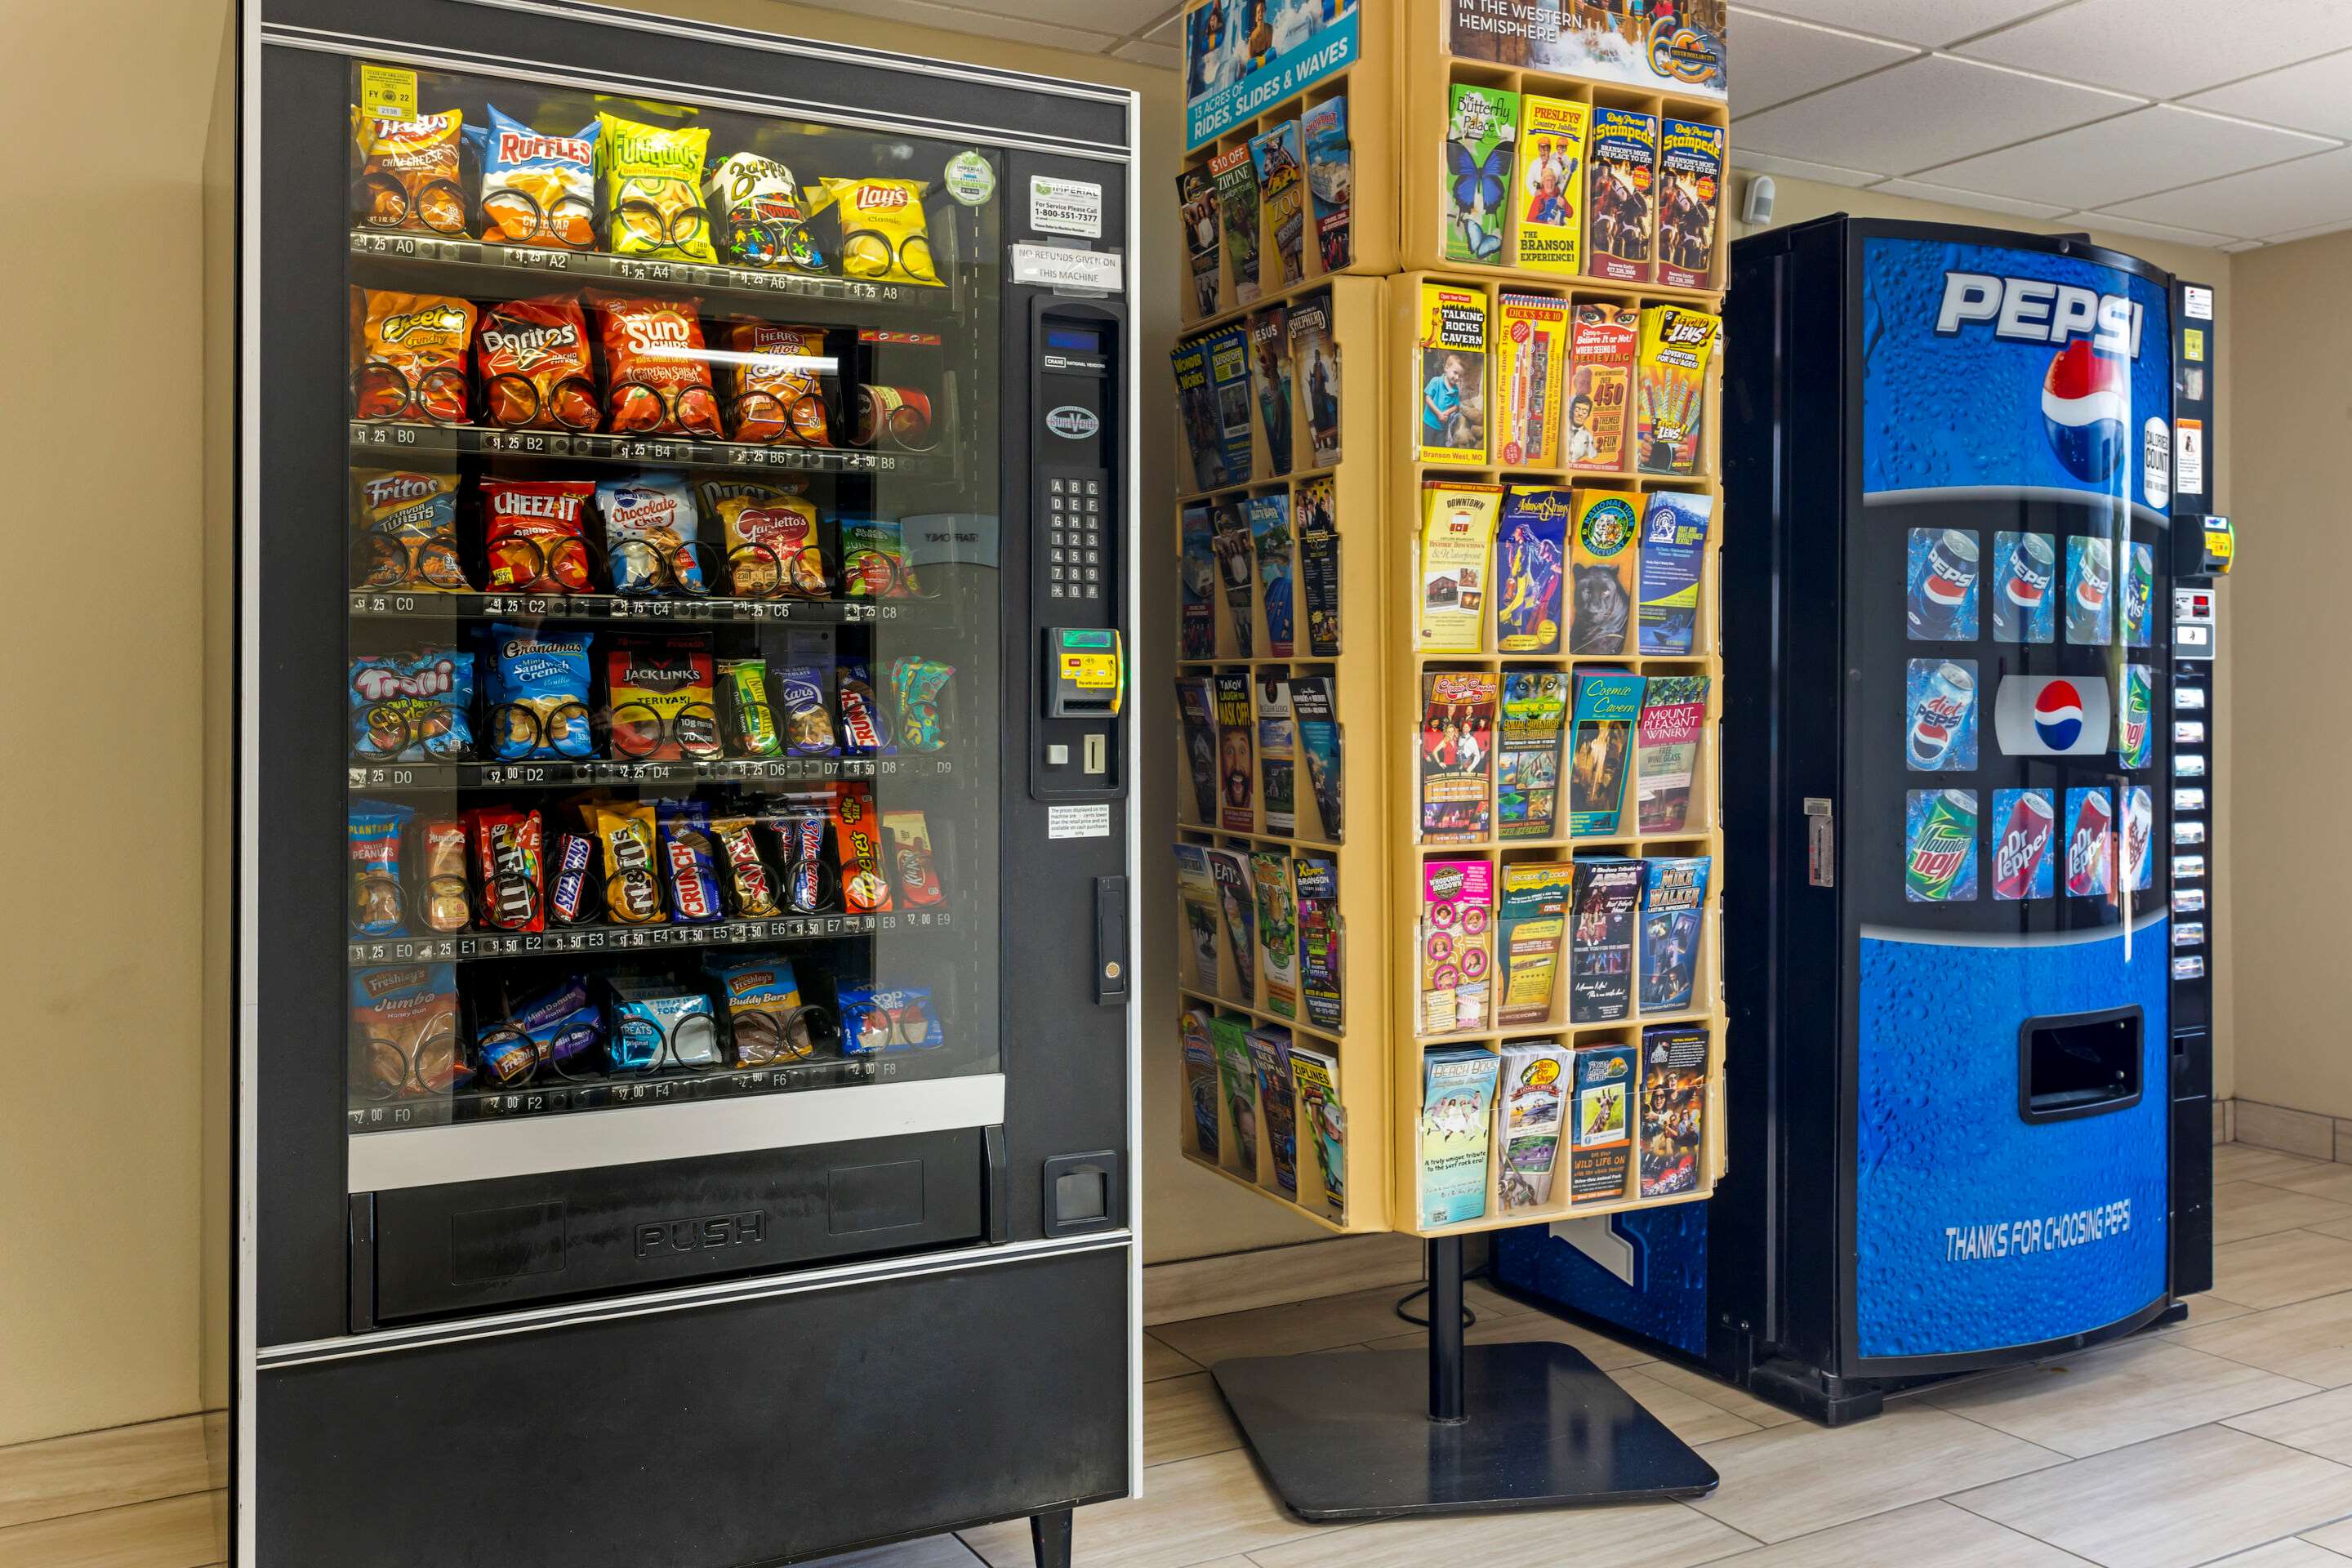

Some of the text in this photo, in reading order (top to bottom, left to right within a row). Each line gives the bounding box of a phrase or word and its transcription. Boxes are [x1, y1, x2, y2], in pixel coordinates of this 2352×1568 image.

[1459, 0, 1582, 29] IN THE WESTERN
[1459, 13, 1556, 42] HEMISPHERE
[1195, 37, 1348, 140] RIDES, SLIDES & WAVES
[1204, 89, 1231, 112] ACRES
[1232, 82, 1245, 97] OF
[1465, 91, 1474, 102] The
[1457, 97, 1510, 124] Butterfly
[1463, 115, 1494, 132] Palace
[1596, 124, 1654, 149] Stampede
[501, 133, 591, 165] RUFFLES
[1663, 135, 1719, 160] Stampede
[1212, 148, 1245, 172] $10 OFF
[1218, 166, 1250, 191] ZIPLINE
[1273, 189, 1301, 221] ZOO
[1036, 209, 1098, 222] 1-800-551-7377
[395, 239, 413, 254] A0
[1521, 240, 1574, 251] BRANSON
[549, 254, 566, 268] A2
[1019, 249, 1116, 267] NO REFUNDS GIVEN ON
[1521, 254, 1575, 262] EXPERIENCE!
[770, 277, 785, 289] A6
[1039, 269, 1098, 282] THIS MACHINE
[883, 287, 898, 300] A8
[1442, 310, 1483, 322] TALKING
[1509, 310, 1561, 320] DICK'S 5 & 10
[1936, 272, 2143, 359] PEPSI
[627, 314, 688, 354] Sun
[1446, 321, 1479, 332] ROCKS
[404, 333, 447, 348] Crunchy
[483, 323, 575, 353] Doritos
[760, 331, 800, 344] HERR'S
[1441, 332, 1482, 345] CAVERN
[770, 345, 800, 355] Hot
[1663, 349, 1696, 361] ADVENTURE
[1575, 354, 1630, 364] BELIEVING
[1681, 359, 1698, 369] AGES!
[1594, 383, 1624, 406] 450
[398, 430, 415, 443] B0
[527, 438, 543, 451] B2
[1423, 450, 1450, 459] Branson
[1452, 452, 1470, 461] West,
[2145, 447, 2168, 473] COUNT
[364, 477, 438, 509] Fritos
[389, 503, 426, 520] FLAVOR
[612, 498, 678, 523] Chocolate
[1446, 498, 1485, 510] DOWNTOWN
[380, 508, 435, 532] TWISTS
[1584, 499, 1635, 527] NATIONAL TIGER
[634, 514, 663, 528] Chip
[1584, 539, 1626, 555] SANCTUARY
[1928, 552, 1976, 588] PEPSI
[2010, 551, 2049, 590] PEPSI
[396, 598, 414, 611] C0
[653, 604, 669, 616] C4
[773, 604, 789, 617] C6
[513, 660, 569, 675] Sandwich
[522, 658, 541, 666] Mini
[358, 662, 452, 698] Trolli
[622, 668, 701, 682] JACK LINK'S
[1220, 679, 1241, 690] YAKOV
[1586, 679, 1632, 697] Cosmic
[638, 697, 691, 706] TERIYAKI
[1593, 697, 1635, 714] Cavern
[1928, 695, 1963, 715] diet
[1220, 702, 1250, 726] MASK OFF!
[1648, 707, 1694, 720] MOUNT
[1916, 706, 1962, 728] PEPSI
[1644, 716, 1698, 730] PLEASANT
[1646, 727, 1690, 739] WINERY
[1659, 746, 1672, 754] FREE
[1663, 753, 1681, 762] GLASS
[394, 770, 412, 784] D0
[653, 766, 669, 778] D4
[770, 764, 785, 776] D6
[843, 798, 854, 824] LARGE
[2008, 829, 2028, 853] Dr
[2078, 827, 2091, 850] Dr
[353, 847, 394, 860] PEANUTS
[1997, 824, 2047, 882] Pepper
[2069, 822, 2107, 878] Pepper
[731, 827, 769, 899] TWIX
[801, 818, 821, 909] 3 Musketeers
[851, 831, 876, 899] Reese's
[555, 835, 589, 915] SNICKERS
[672, 842, 702, 915] CRUNCH
[1298, 875, 1329, 885] BRANSON
[1660, 869, 1695, 888] MIKE
[1649, 888, 1700, 907] WALKER
[396, 944, 412, 957] E0
[526, 938, 541, 950] E2
[374, 992, 435, 1013] Jumbo
[729, 992, 786, 1006] Buddy Bars
[387, 1007, 426, 1019] Honey Bun
[620, 1027, 653, 1035] TREATS
[1294, 1063, 1330, 1085] ZIPLINES
[1433, 1062, 1499, 1079] BEACH BOYS
[656, 1085, 669, 1097] F4
[1446, 1155, 1464, 1163] unique
[1575, 1159, 1592, 1169] WILD
[1614, 1156, 1625, 1165] ON
[639, 1215, 762, 1256] PUSH
[1945, 1198, 2131, 1262] THANKS FOR CHOOSING PEPSI
